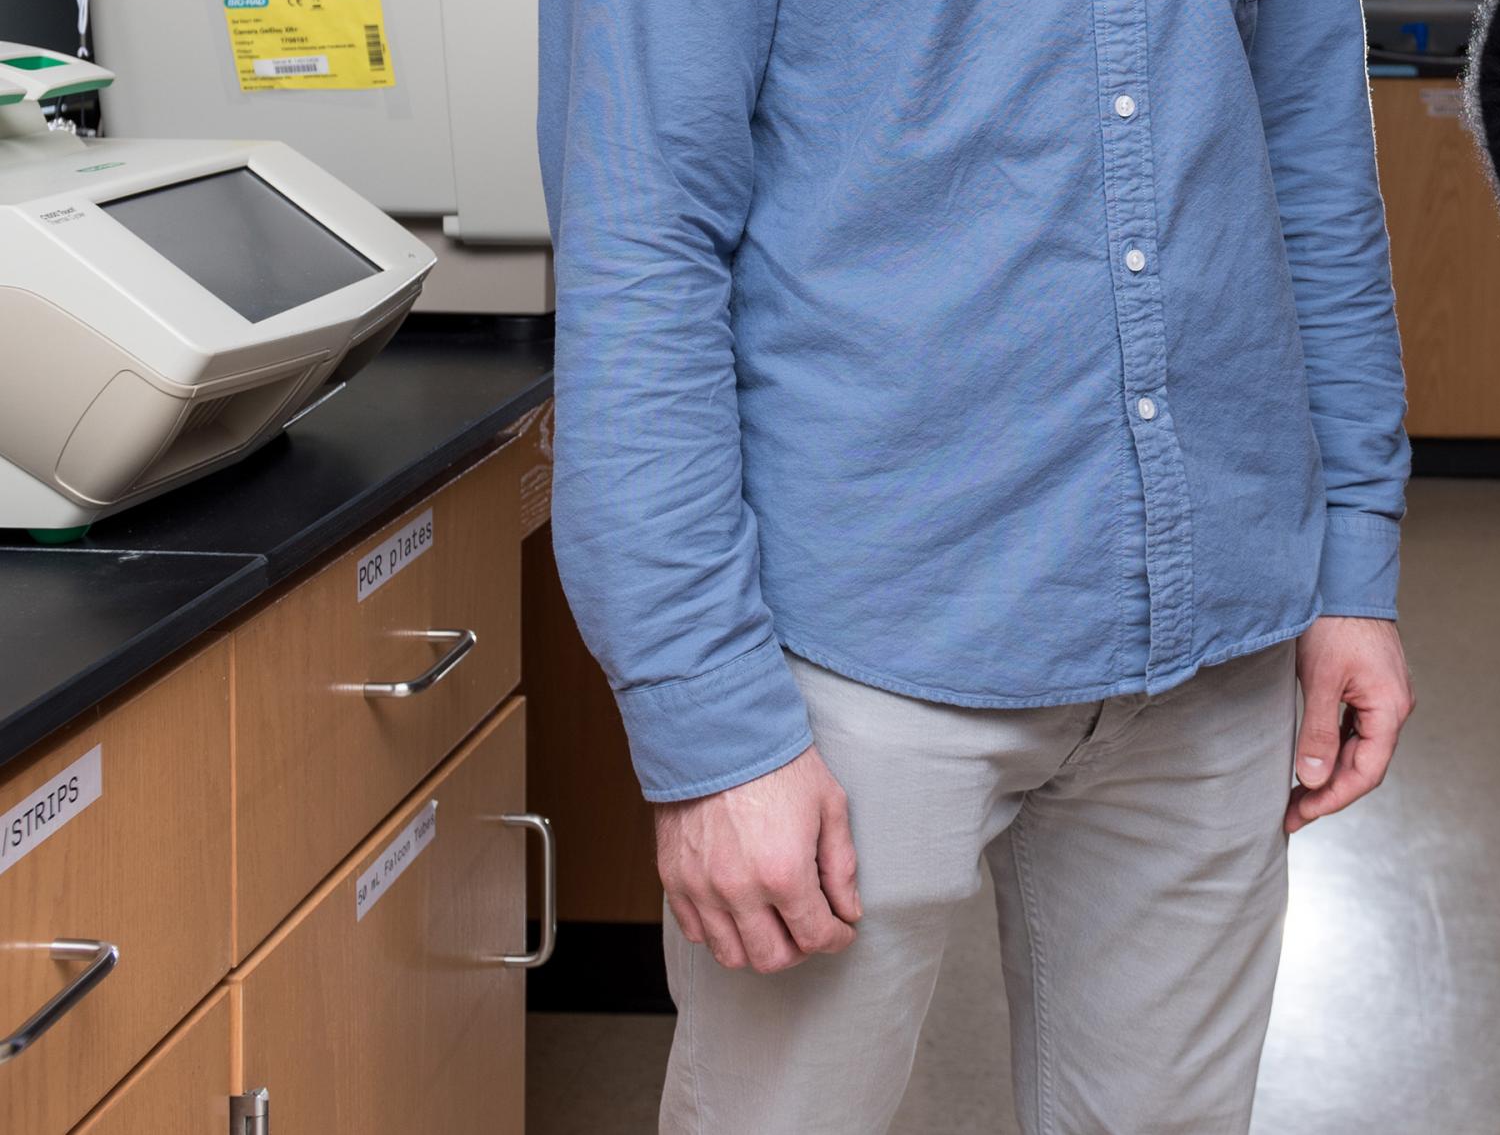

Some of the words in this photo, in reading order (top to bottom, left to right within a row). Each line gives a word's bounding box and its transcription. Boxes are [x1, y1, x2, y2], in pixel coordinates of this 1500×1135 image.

[359, 554, 383, 593] PCR
[389, 521, 432, 575] plates
[384, 840, 411, 877] Falcon
